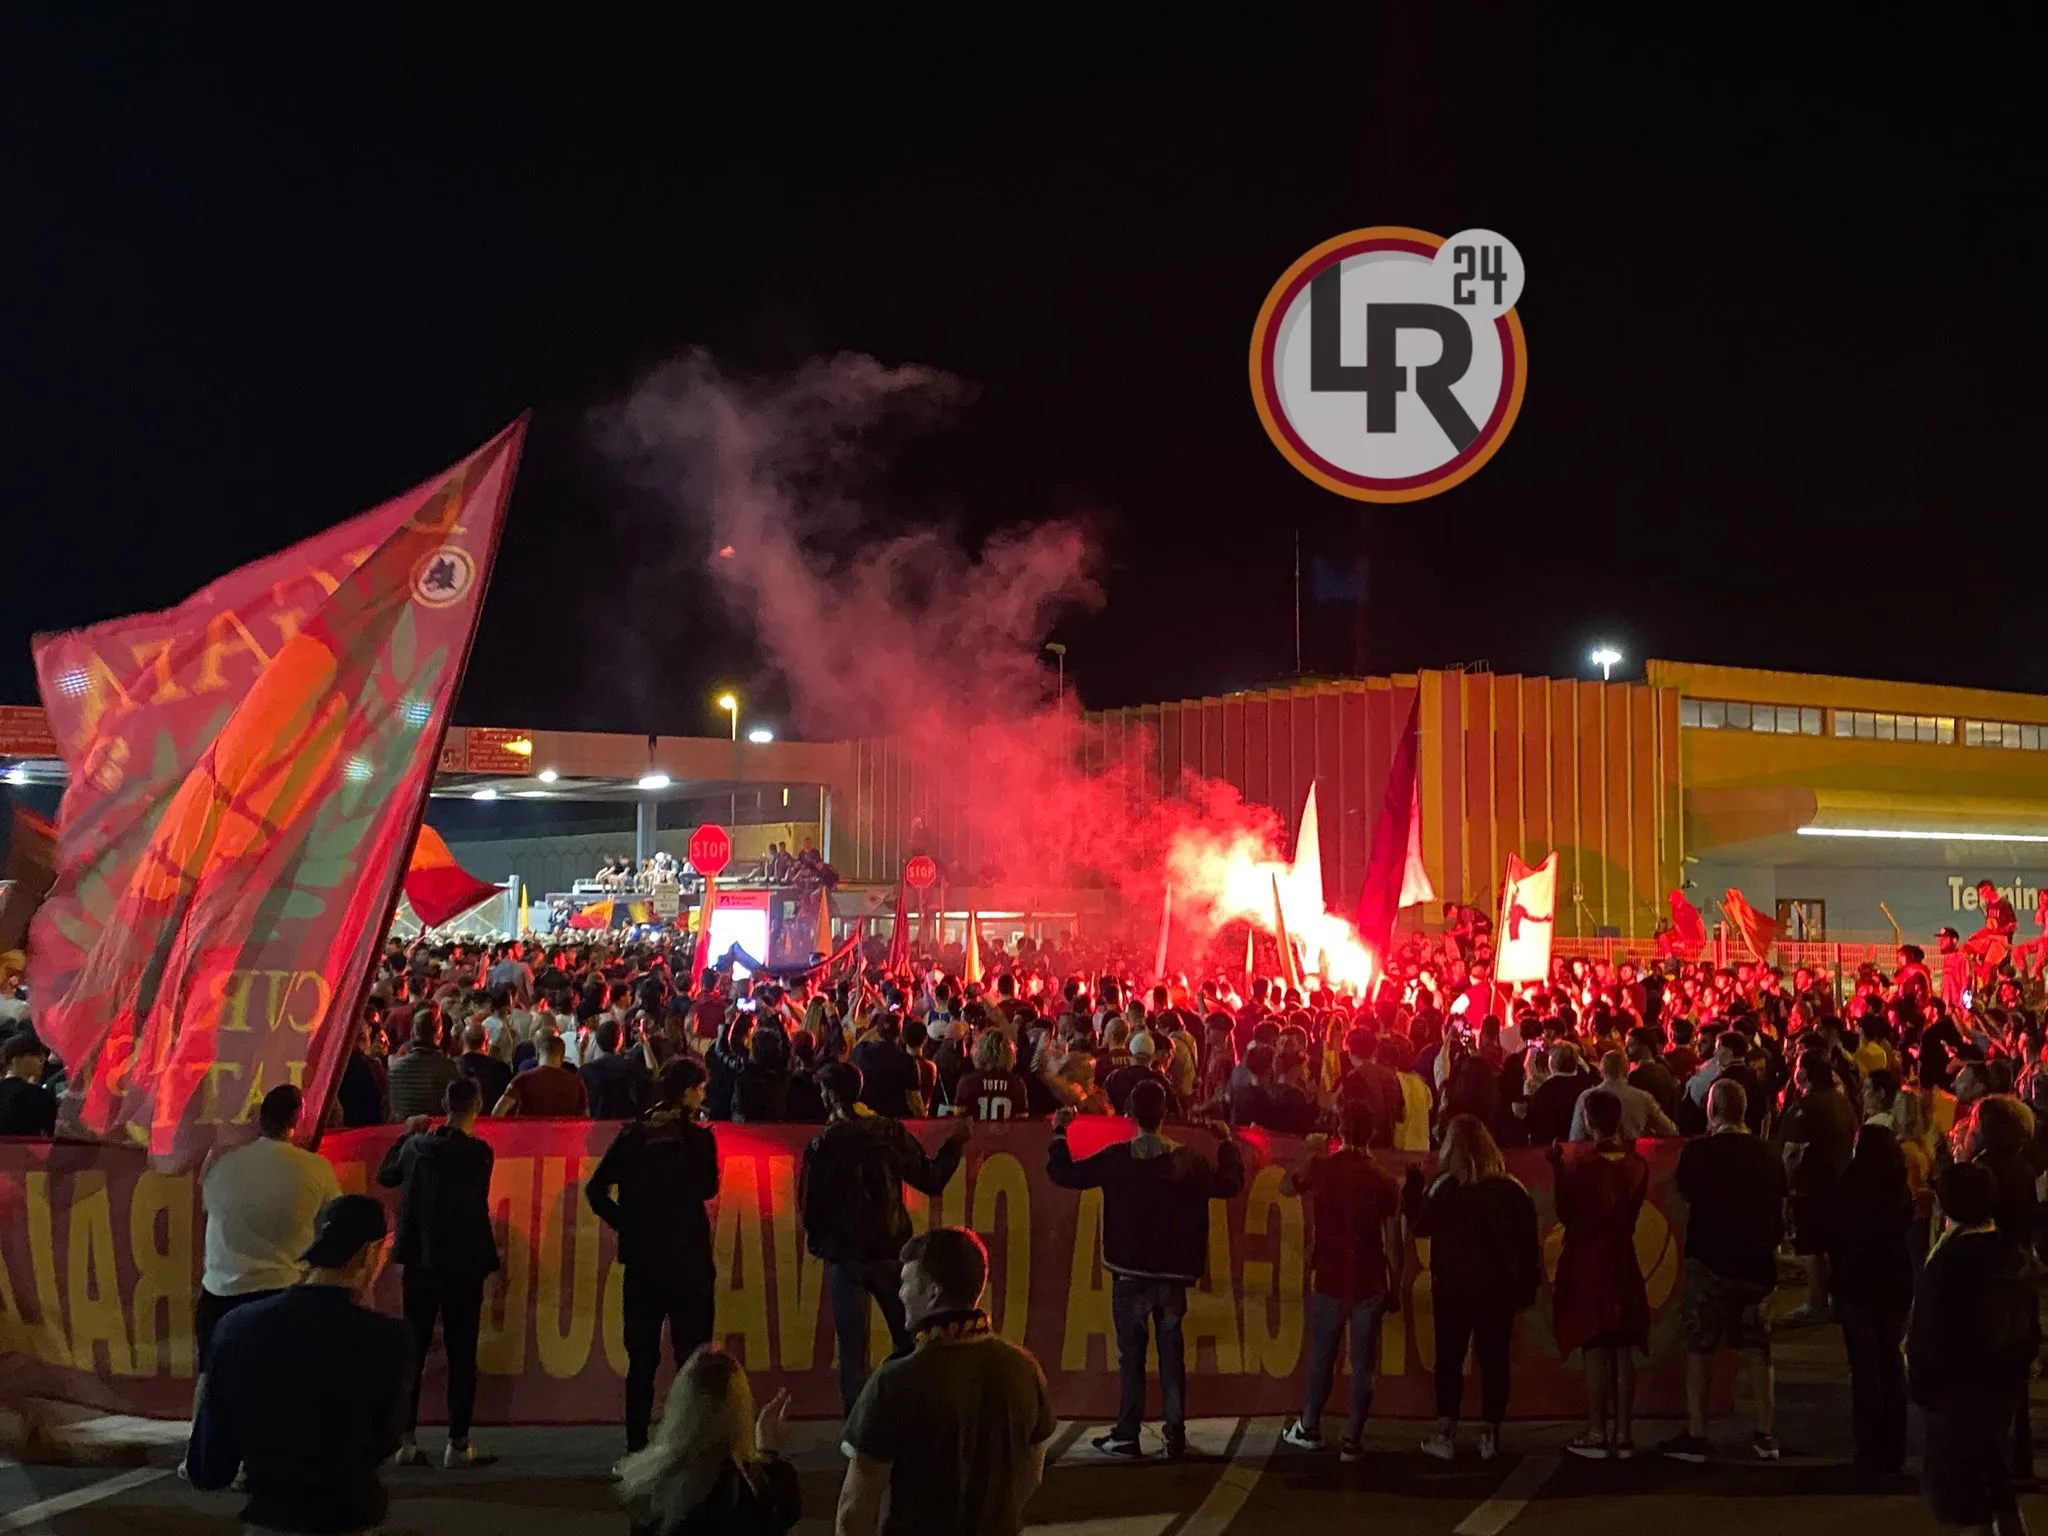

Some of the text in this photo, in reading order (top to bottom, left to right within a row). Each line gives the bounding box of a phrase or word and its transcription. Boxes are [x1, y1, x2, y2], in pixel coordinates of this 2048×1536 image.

[692, 840, 728, 860] STOP
[908, 866, 934, 878] STOP
[982, 1078, 1008, 1092] TOTTI
[978, 1096, 1012, 1120] 10
